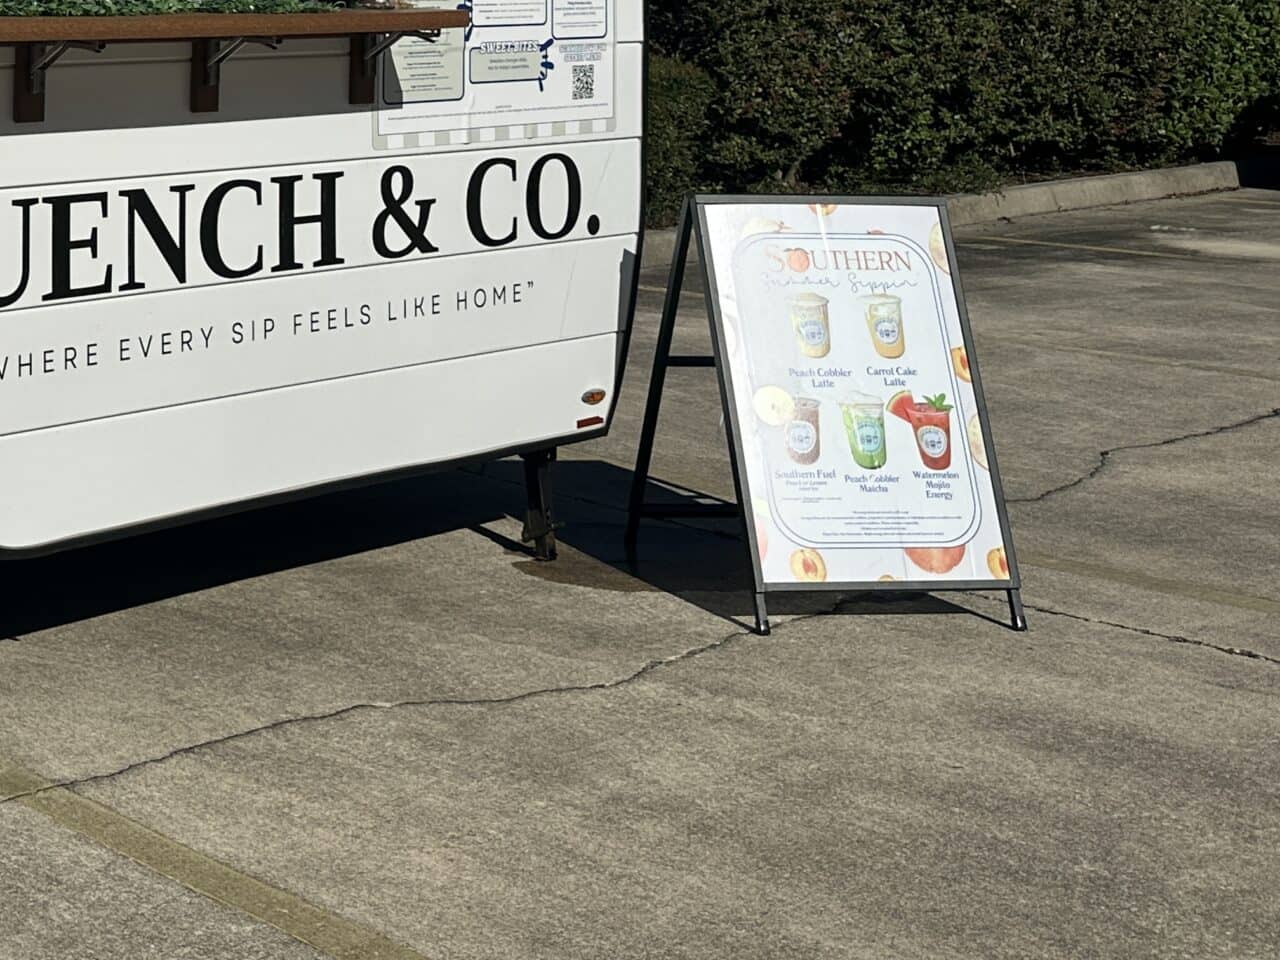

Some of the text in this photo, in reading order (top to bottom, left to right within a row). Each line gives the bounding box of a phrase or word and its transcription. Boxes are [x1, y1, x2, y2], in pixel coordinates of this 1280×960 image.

[479, 42, 511, 54] SWEET
[372, 164, 438, 259] &
[466, 152, 601, 247] CO.
[119, 326, 214, 362] EVERY
[232, 318, 277, 345] SIP
[292, 303, 372, 336] FEELS
[387, 293, 441, 321] LIKE
[817, 368, 852, 377] Cobbler
[866, 367, 918, 377] Carrot Cake
[812, 378, 835, 388] Latte
[883, 378, 907, 387] Latte
[816, 469, 837, 479] Fuel
[844, 474, 899, 483] Peach Cobbler
[912, 470, 960, 480] Watermelon
[859, 484, 888, 493] Matcha
[925, 480, 951, 490] Mojito
[926, 489, 953, 500] Energy
